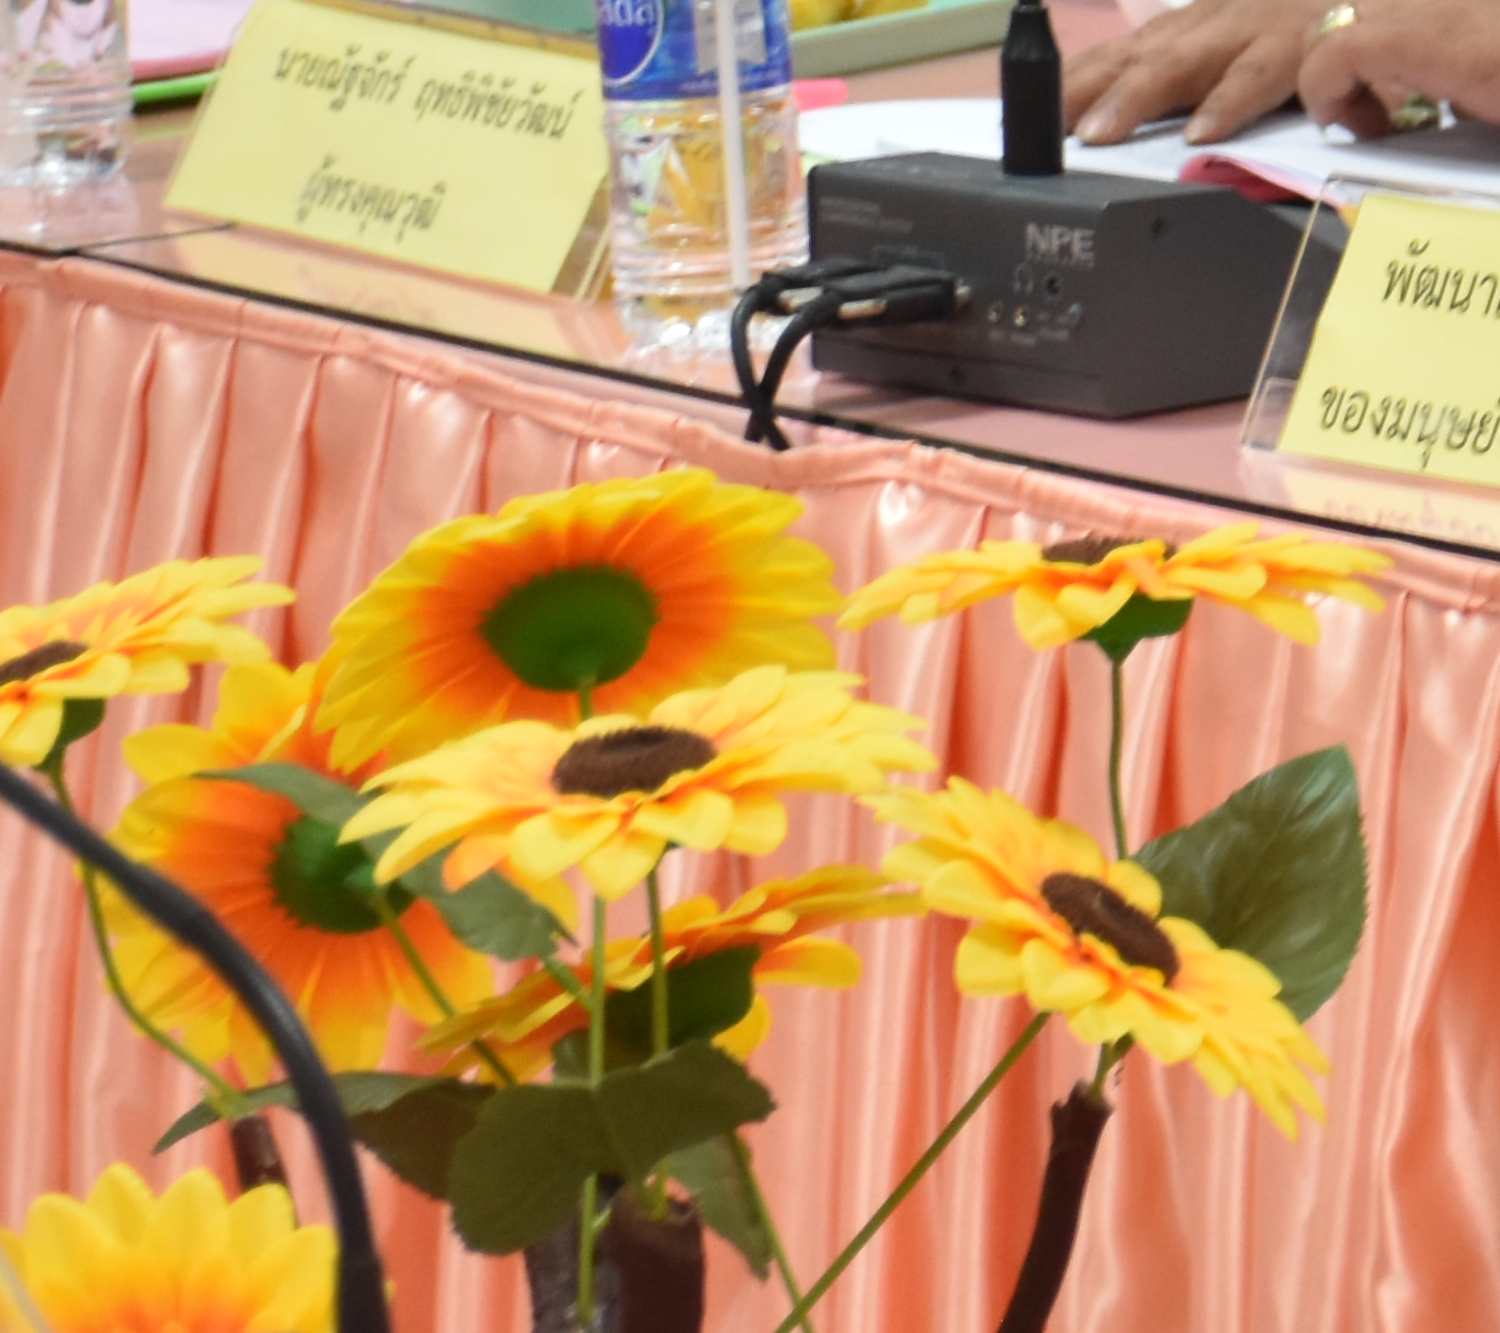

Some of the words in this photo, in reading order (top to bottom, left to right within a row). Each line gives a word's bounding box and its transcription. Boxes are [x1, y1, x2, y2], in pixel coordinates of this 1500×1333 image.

[296, 152, 447, 245] ผู้ทรงคุณวุฒิ
[1024, 222, 1096, 261] NPE
